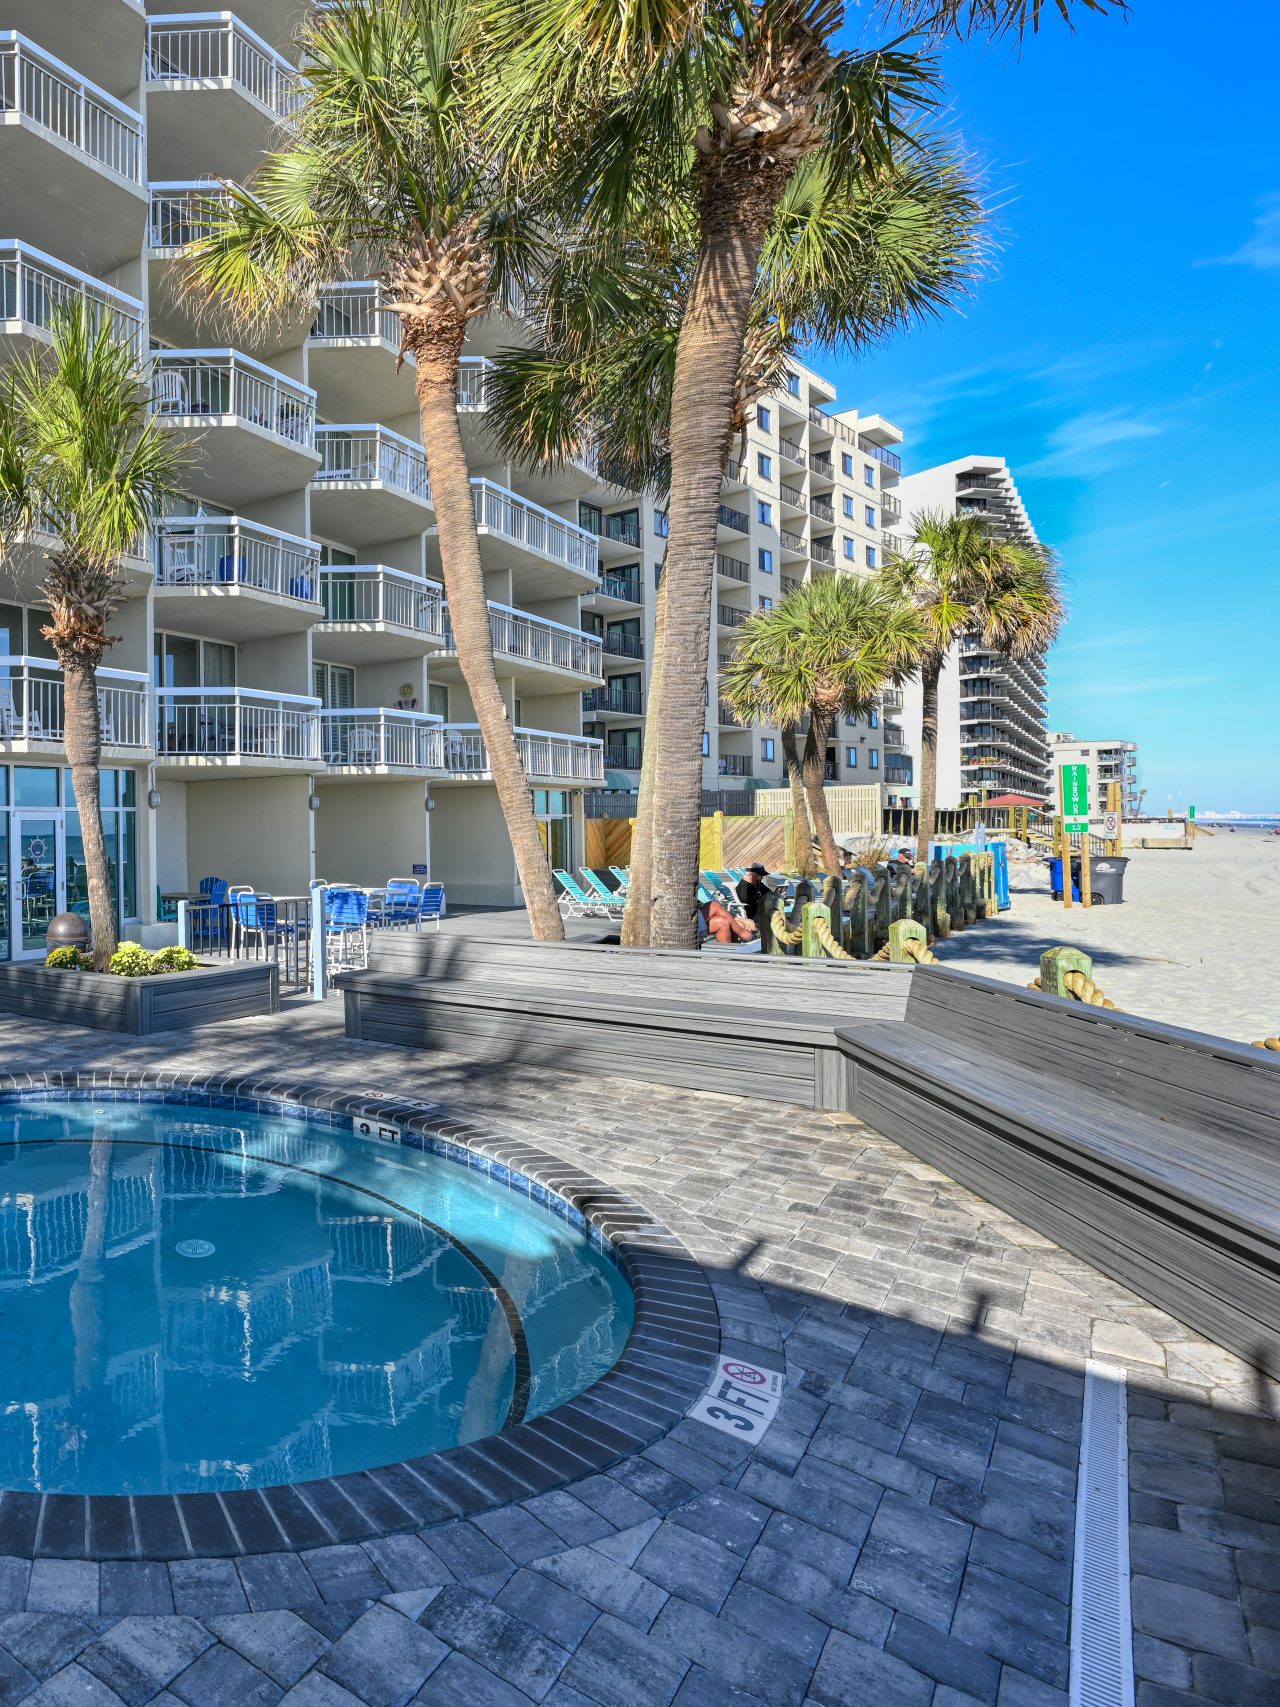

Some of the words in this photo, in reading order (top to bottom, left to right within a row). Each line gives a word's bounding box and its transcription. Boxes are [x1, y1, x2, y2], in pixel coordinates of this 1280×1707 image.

[1073, 804, 1078, 814] DR
[717, 1380, 769, 1415] FT
[706, 1406, 754, 1431] 3
